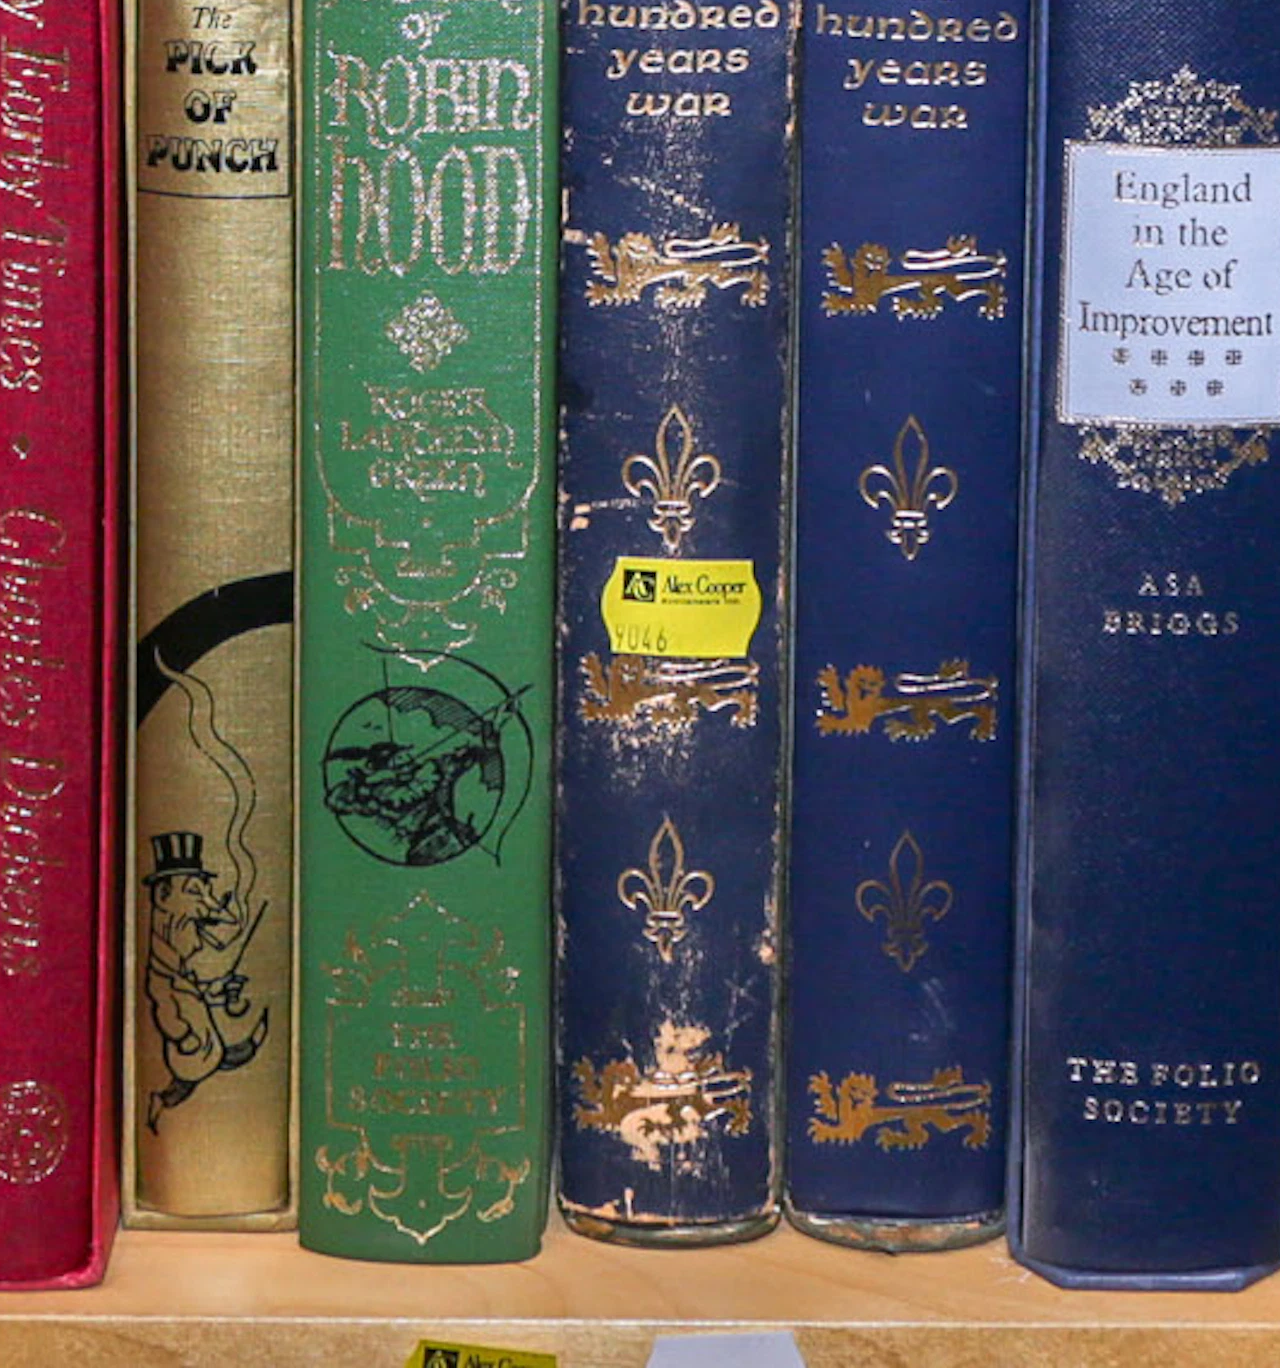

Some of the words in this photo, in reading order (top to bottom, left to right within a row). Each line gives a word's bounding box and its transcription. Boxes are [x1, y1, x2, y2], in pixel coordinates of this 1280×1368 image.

[192, 7, 232, 29] The
[165, 40, 256, 75] PICK
[184, 88, 236, 124] OF
[627, 92, 731, 117] war
[862, 103, 967, 128] war
[146, 134, 278, 172] PUNCH
[1114, 170, 1254, 207] England
[1133, 218, 1164, 247] in
[1177, 217, 1228, 247] the
[1125, 258, 1191, 295] Age
[1202, 259, 1239, 290] of
[1078, 301, 1274, 341] Improvement
[663, 575, 693, 594] Alex
[697, 575, 746, 599] Cooper
[1138, 571, 1204, 597] ASA
[1102, 612, 1240, 635] BRIGGS
[1067, 1057, 1139, 1085] THE
[1151, 1061, 1261, 1088] FOLIO
[1084, 1096, 1243, 1125] SOCIETY
